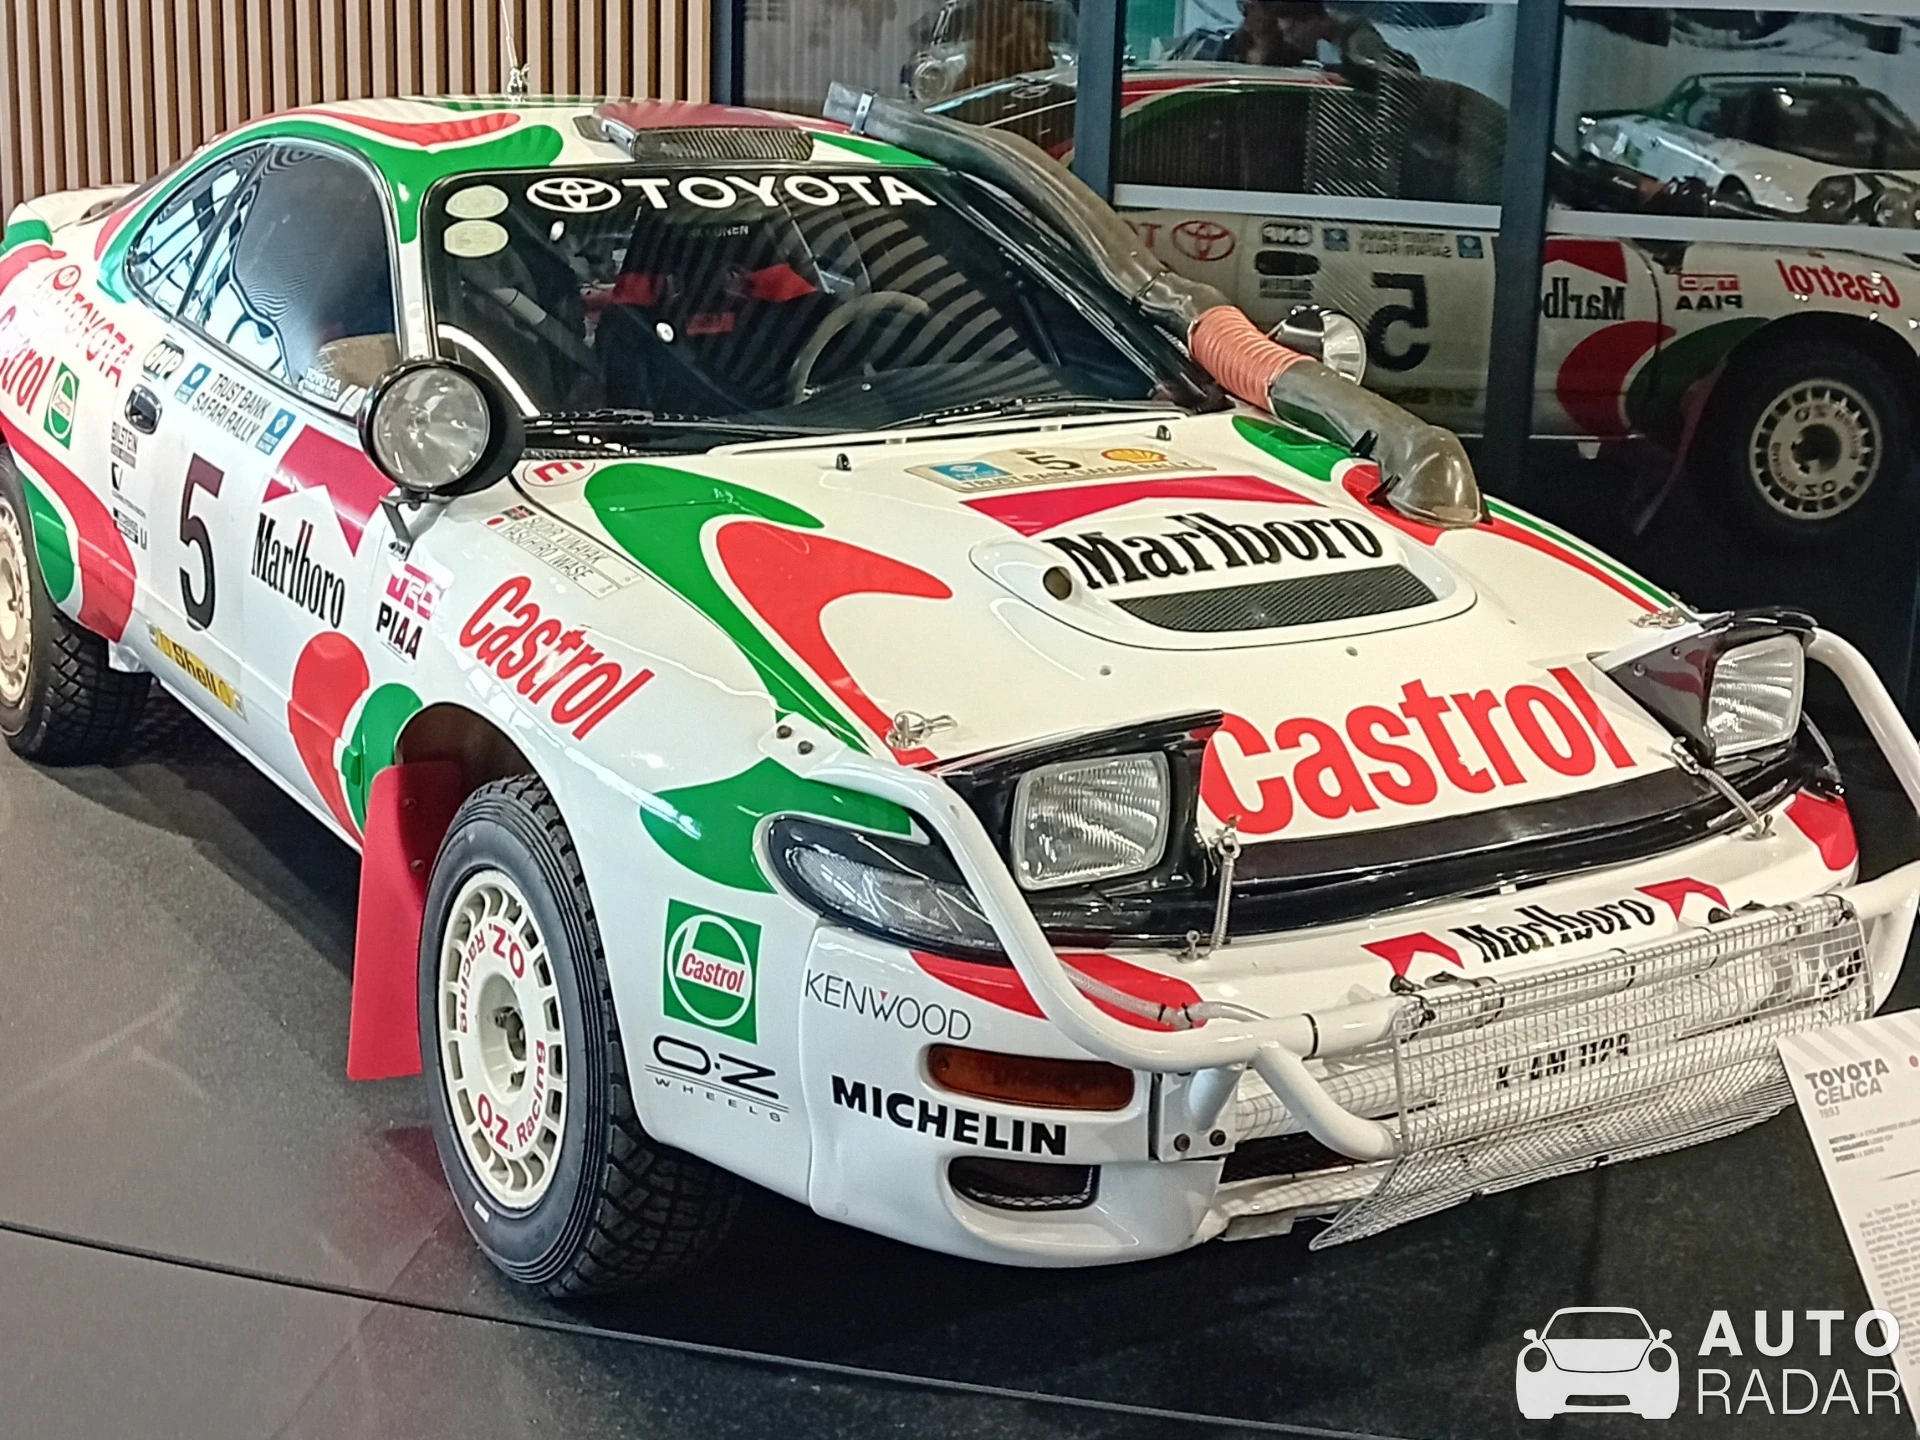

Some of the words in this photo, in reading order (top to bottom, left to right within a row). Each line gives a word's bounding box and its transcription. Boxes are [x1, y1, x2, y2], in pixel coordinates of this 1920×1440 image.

[621, 174, 937, 209] TOYOTA
[143, 340, 185, 380] OMP
[192, 392, 229, 427] SAFARI
[223, 410, 260, 444] RALLY
[210, 373, 246, 404] TRUST
[237, 390, 272, 420] BANK
[1026, 454, 1082, 471] 5
[180, 452, 225, 632] 5
[250, 511, 345, 630] Marlboro
[550, 551, 594, 582] IWASE
[1042, 511, 1384, 590] Marlboro
[376, 601, 423, 660] PIAA
[459, 576, 655, 741] Castrol
[172, 641, 219, 699] Shell
[1201, 667, 1636, 834] Castrol
[1448, 899, 1656, 963] Marlboro
[682, 953, 746, 993] Castrol
[805, 969, 972, 1040] KENWOOD
[516, 1040, 547, 1148] Racing
[654, 1077, 782, 1123] WHEELS
[1804, 1058, 1890, 1090] TOYOTA
[1814, 1077, 1883, 1107] CELICA
[831, 1075, 1067, 1156] MICHELIN
